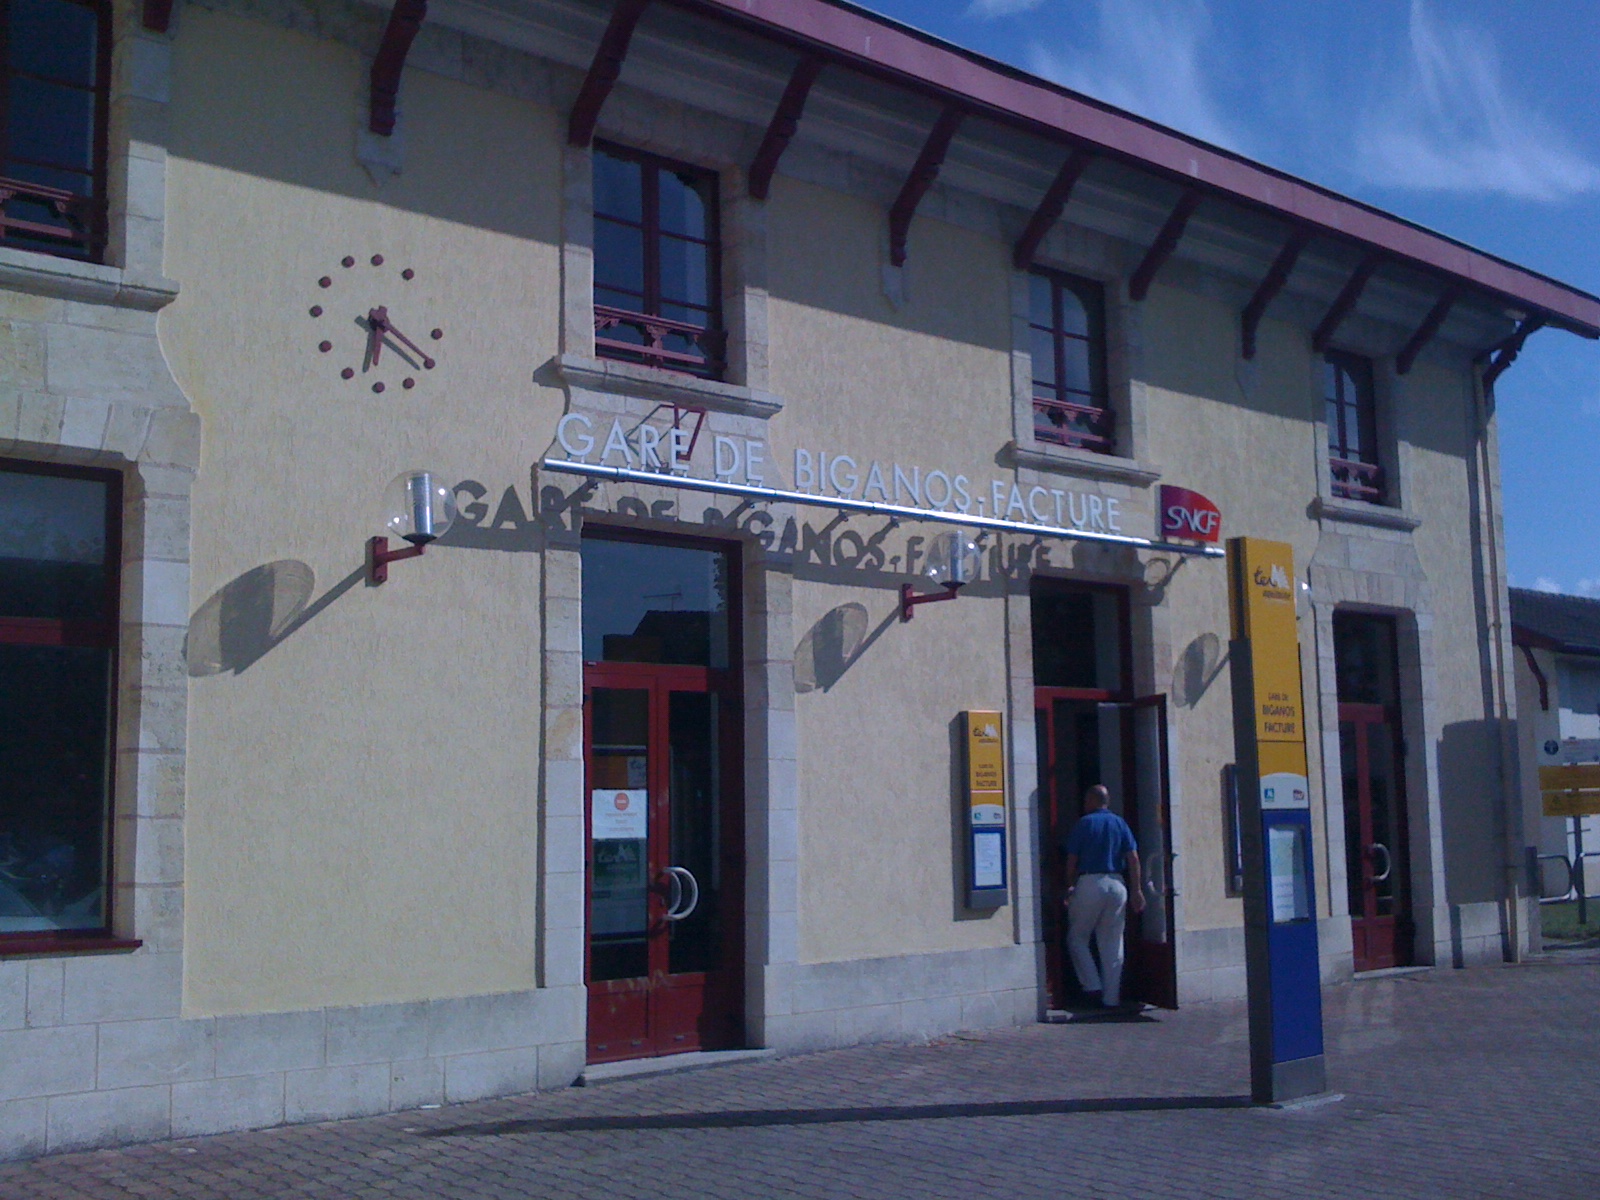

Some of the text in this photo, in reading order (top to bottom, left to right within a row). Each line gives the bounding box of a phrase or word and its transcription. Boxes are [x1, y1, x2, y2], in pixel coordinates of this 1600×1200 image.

[557, 413, 691, 471] GARE
[714, 436, 764, 482] DE
[1165, 506, 1219, 534] SNCF
[1262, 704, 1295, 717] BIGANOS
[1264, 721, 1295, 734] FACTURE
